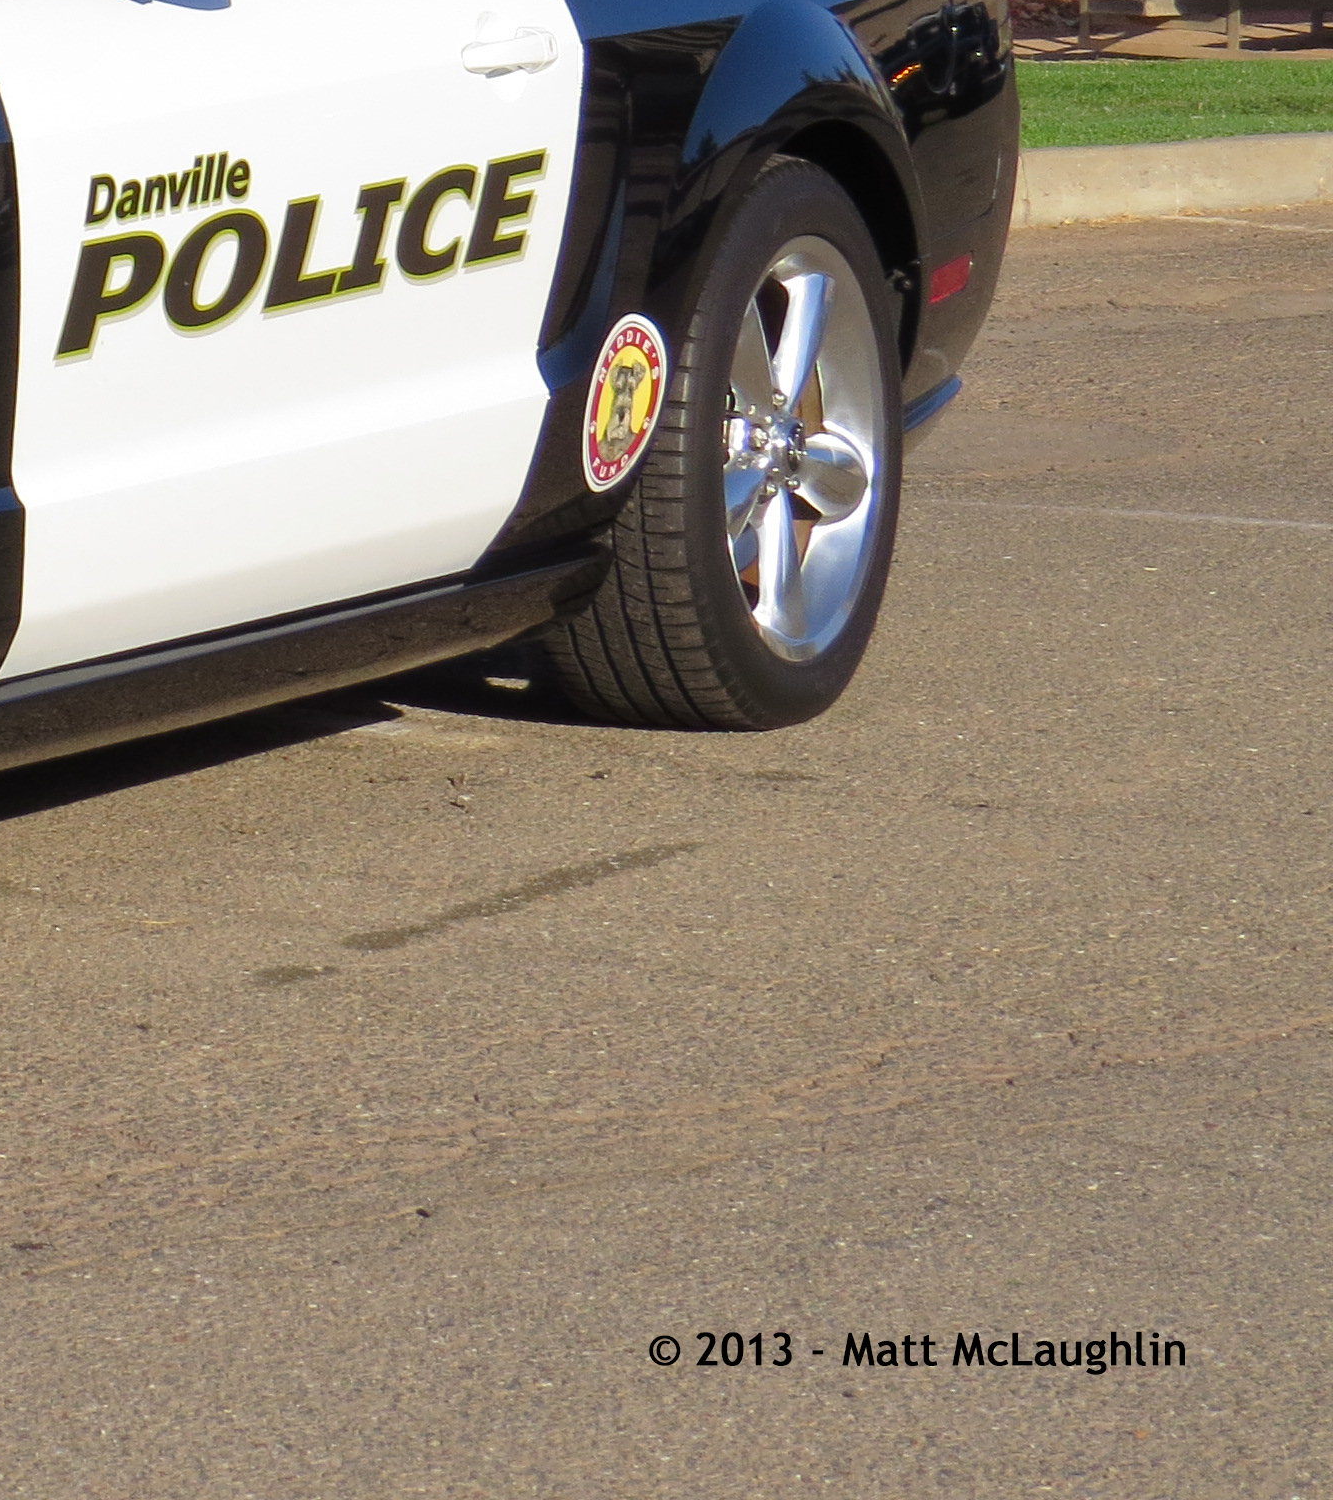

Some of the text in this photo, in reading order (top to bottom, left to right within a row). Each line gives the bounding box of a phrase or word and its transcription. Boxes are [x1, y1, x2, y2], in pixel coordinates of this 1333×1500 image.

[84, 150, 251, 227] Danville
[53, 148, 547, 366] POLICE
[598, 329, 660, 384] MADDIE'S
[591, 453, 630, 480] FUND
